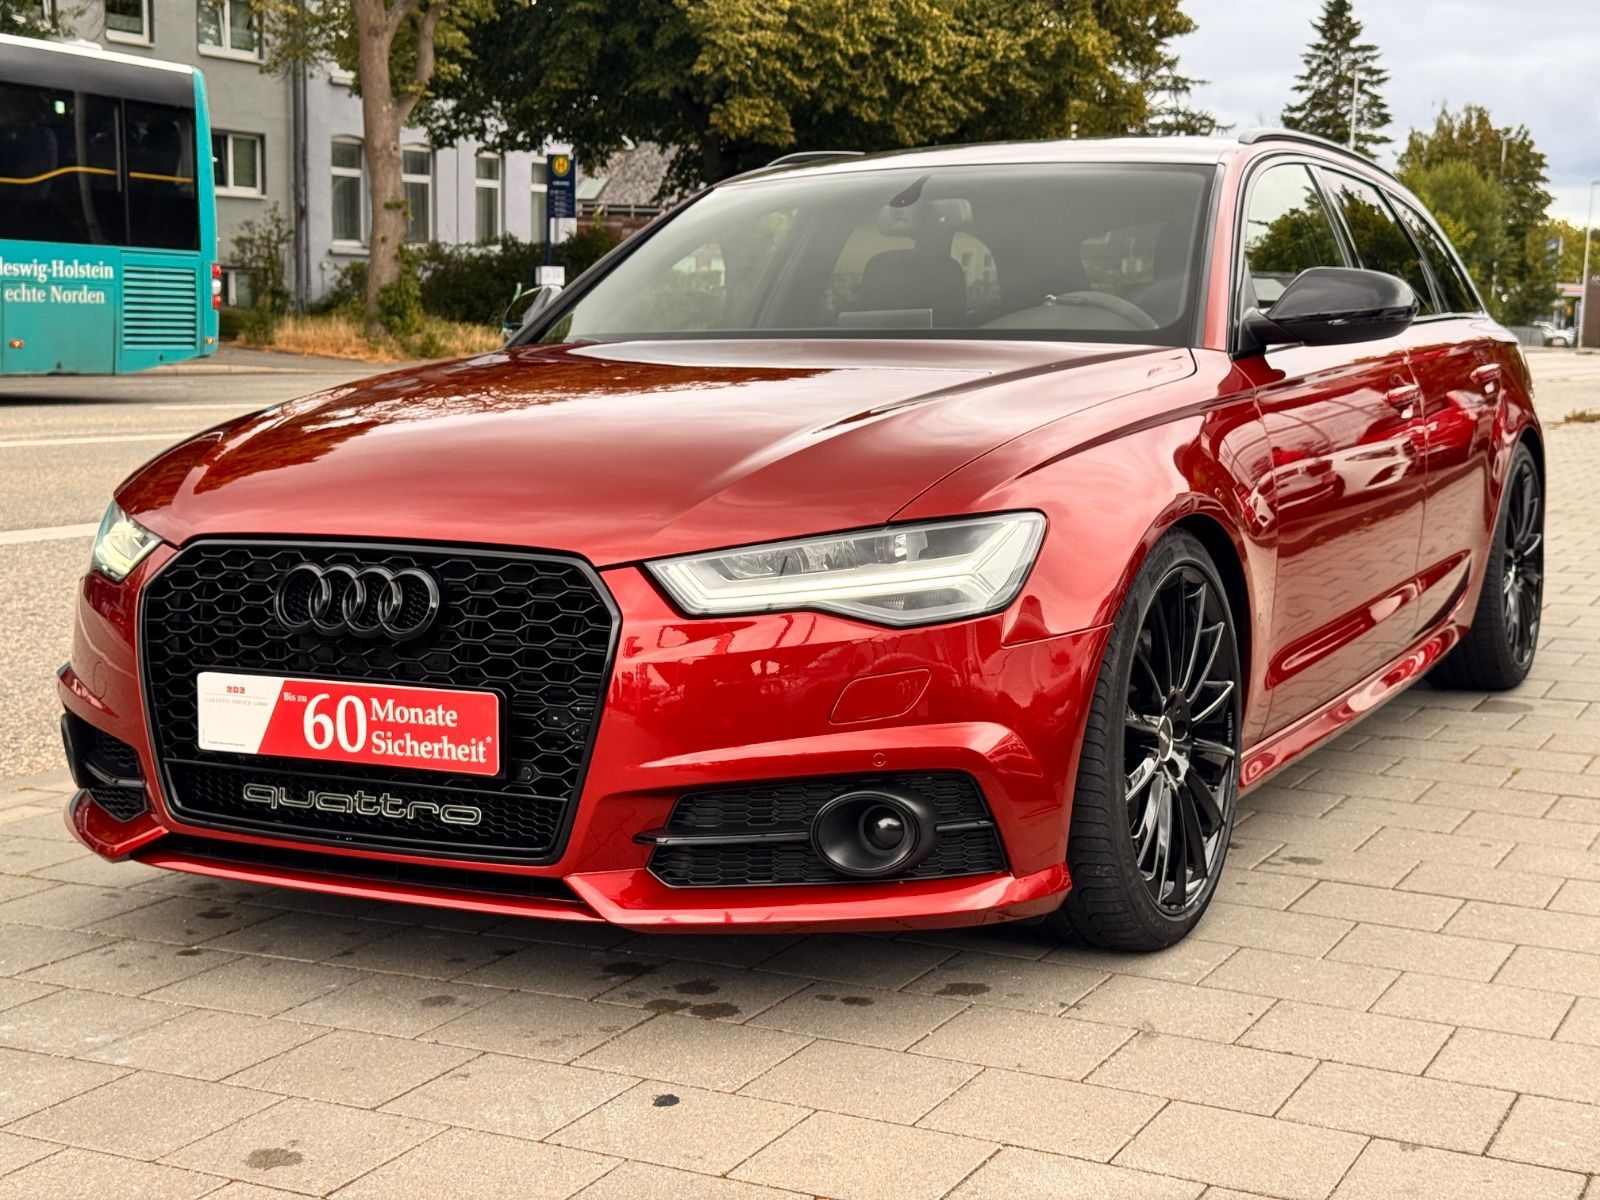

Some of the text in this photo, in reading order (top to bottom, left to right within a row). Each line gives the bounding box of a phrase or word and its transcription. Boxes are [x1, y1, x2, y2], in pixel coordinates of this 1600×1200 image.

[5, 283, 105, 304] echte Norden
[283, 691, 308, 703] Bis zu
[370, 697, 458, 727] Monate
[303, 693, 367, 753] 60
[243, 783, 482, 825] quattro
